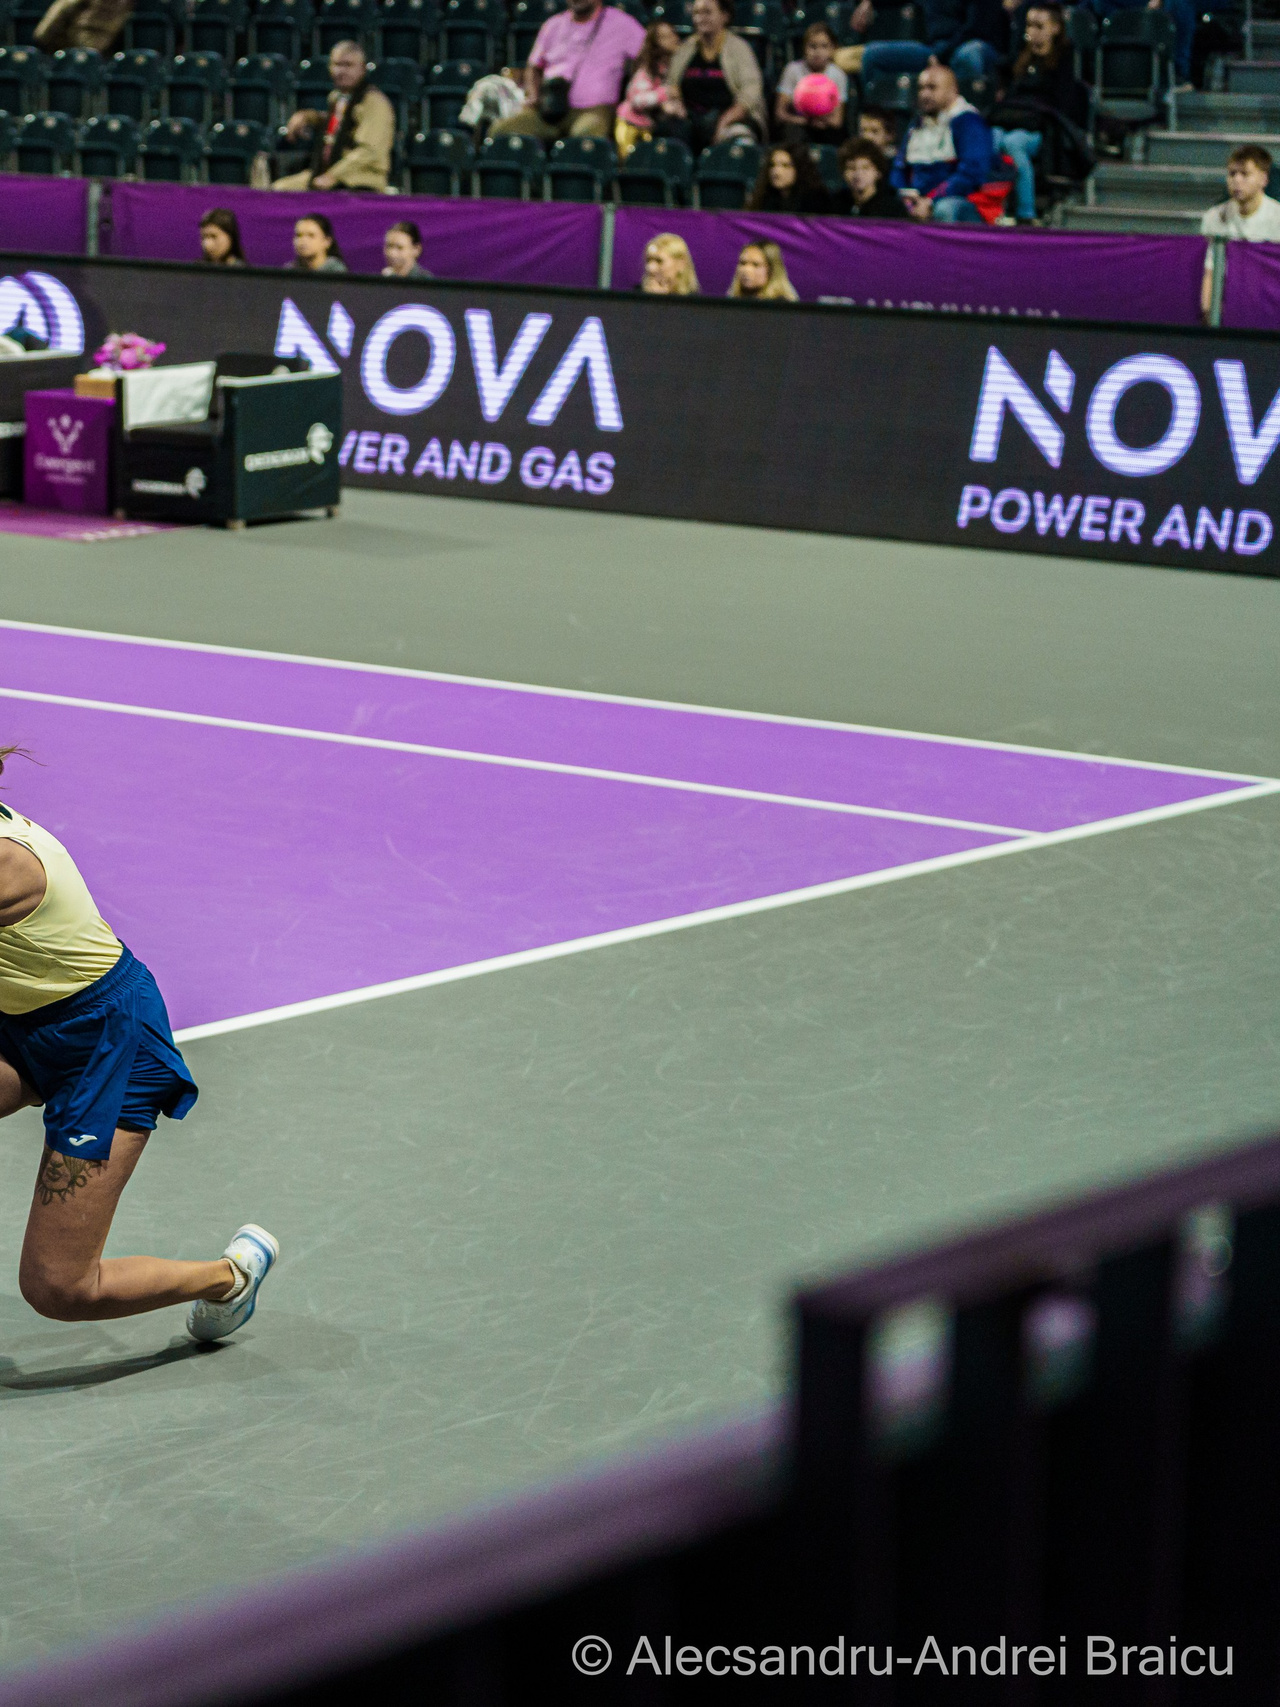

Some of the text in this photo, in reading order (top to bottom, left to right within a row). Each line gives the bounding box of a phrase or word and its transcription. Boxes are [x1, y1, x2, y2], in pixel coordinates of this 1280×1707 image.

[274, 297, 624, 432] NOVA
[413, 437, 512, 485] AND
[520, 446, 617, 495] GAS
[957, 484, 1274, 556] POWER AND
